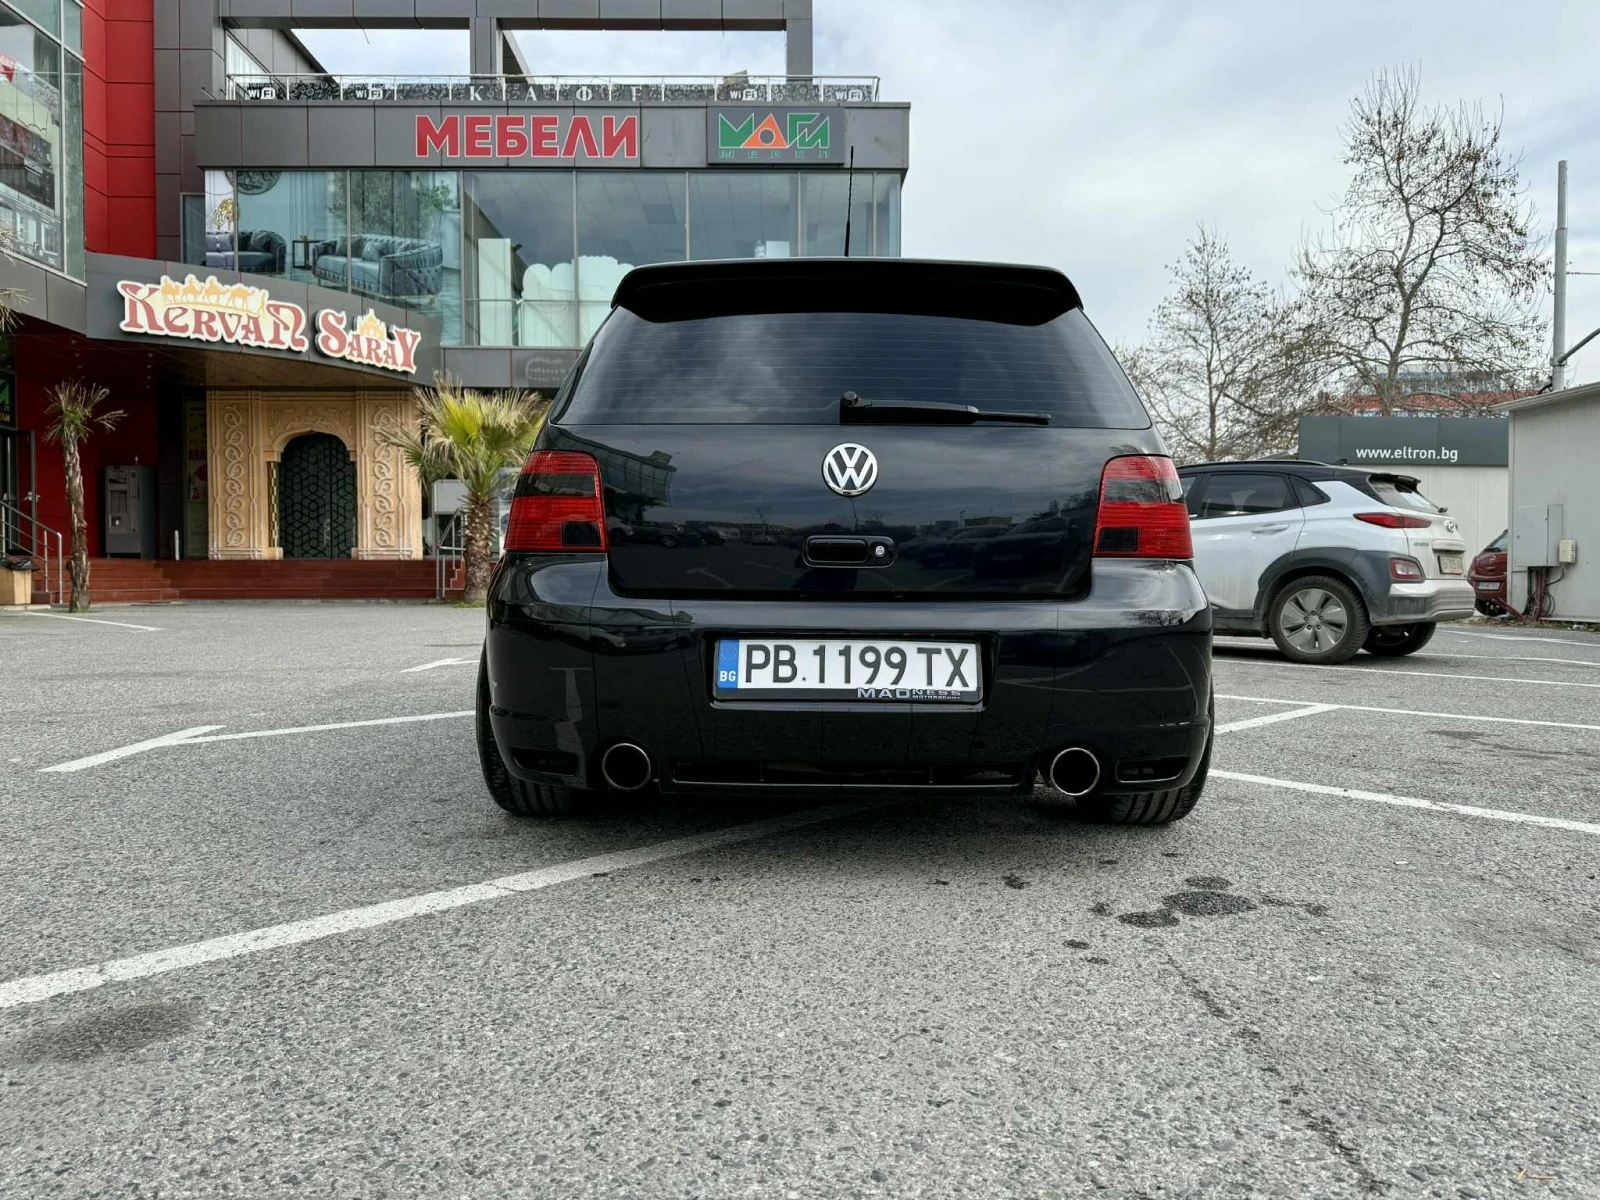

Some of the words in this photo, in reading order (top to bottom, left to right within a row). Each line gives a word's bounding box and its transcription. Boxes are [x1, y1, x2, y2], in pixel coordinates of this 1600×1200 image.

[415, 115, 638, 158] МЕБЕЛИ
[1356, 446, 1458, 462] www.eltron.bg
[719, 671, 736, 682] BG
